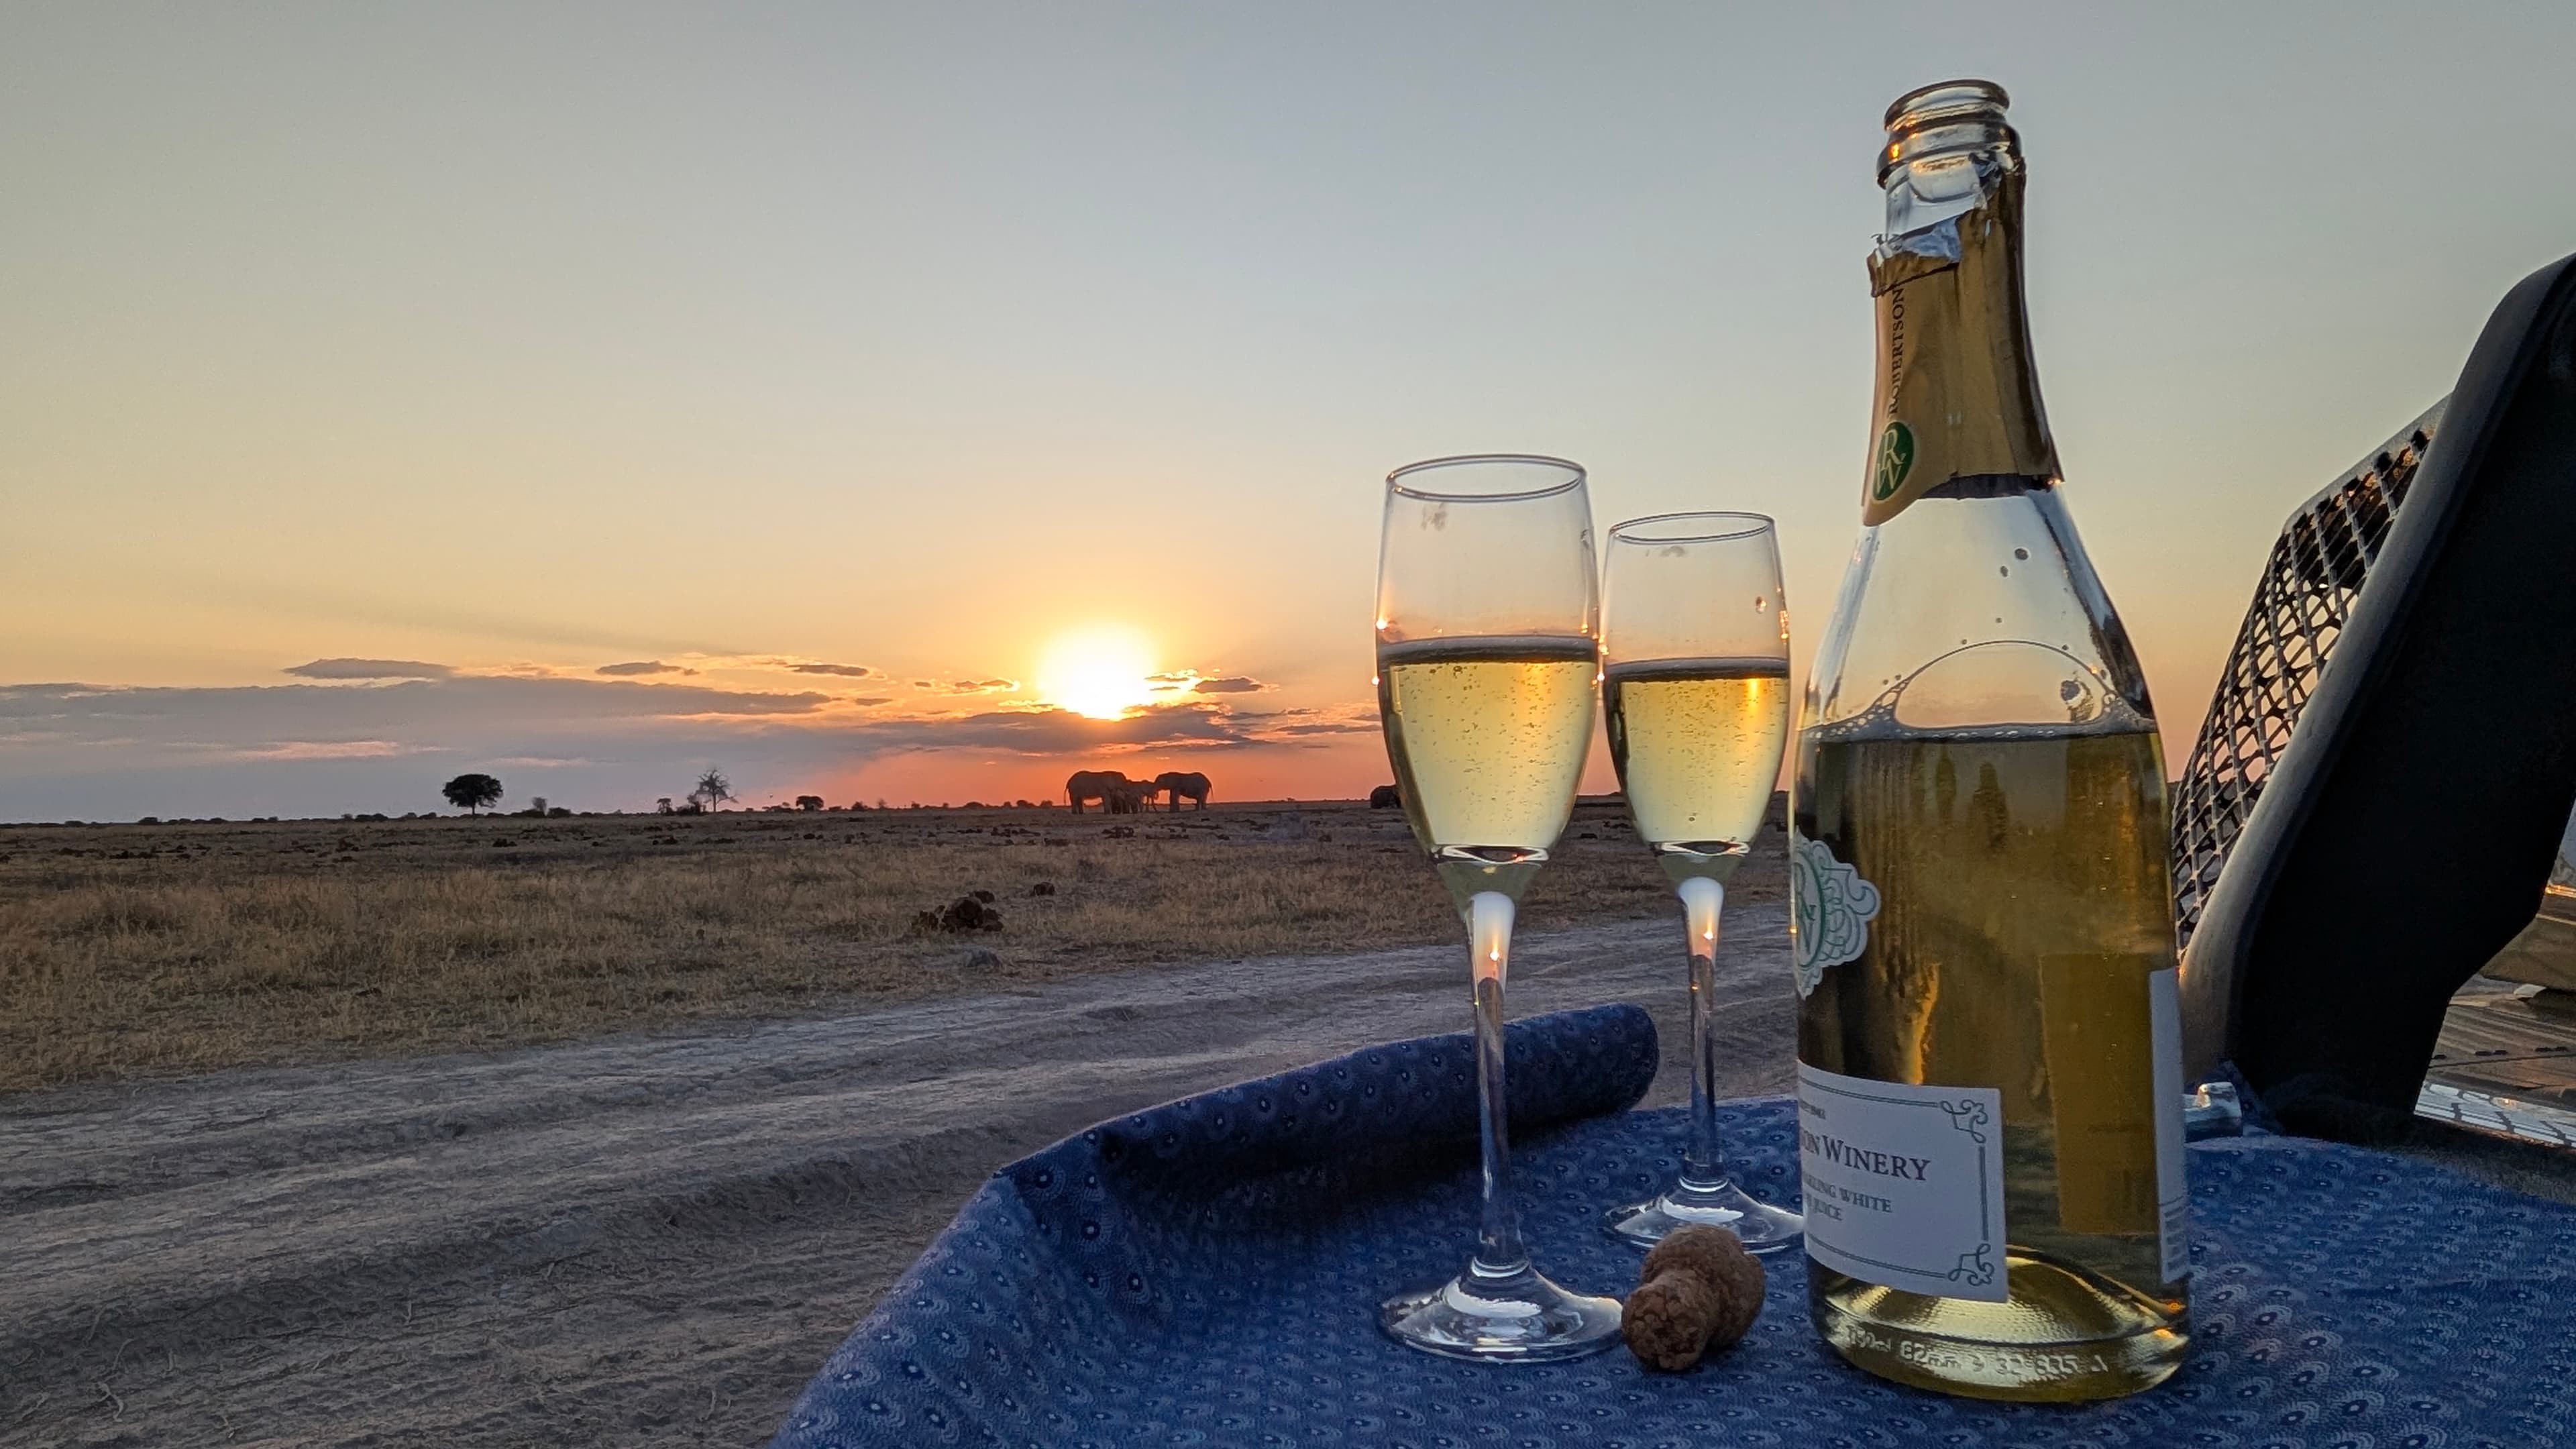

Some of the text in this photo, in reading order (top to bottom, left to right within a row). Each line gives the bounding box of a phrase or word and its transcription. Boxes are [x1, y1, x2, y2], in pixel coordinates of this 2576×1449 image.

[1888, 288, 1904, 417] ROBERTSON
[1821, 1134, 1931, 1181] WINERY
[1839, 1187, 1892, 1213] WHITE
